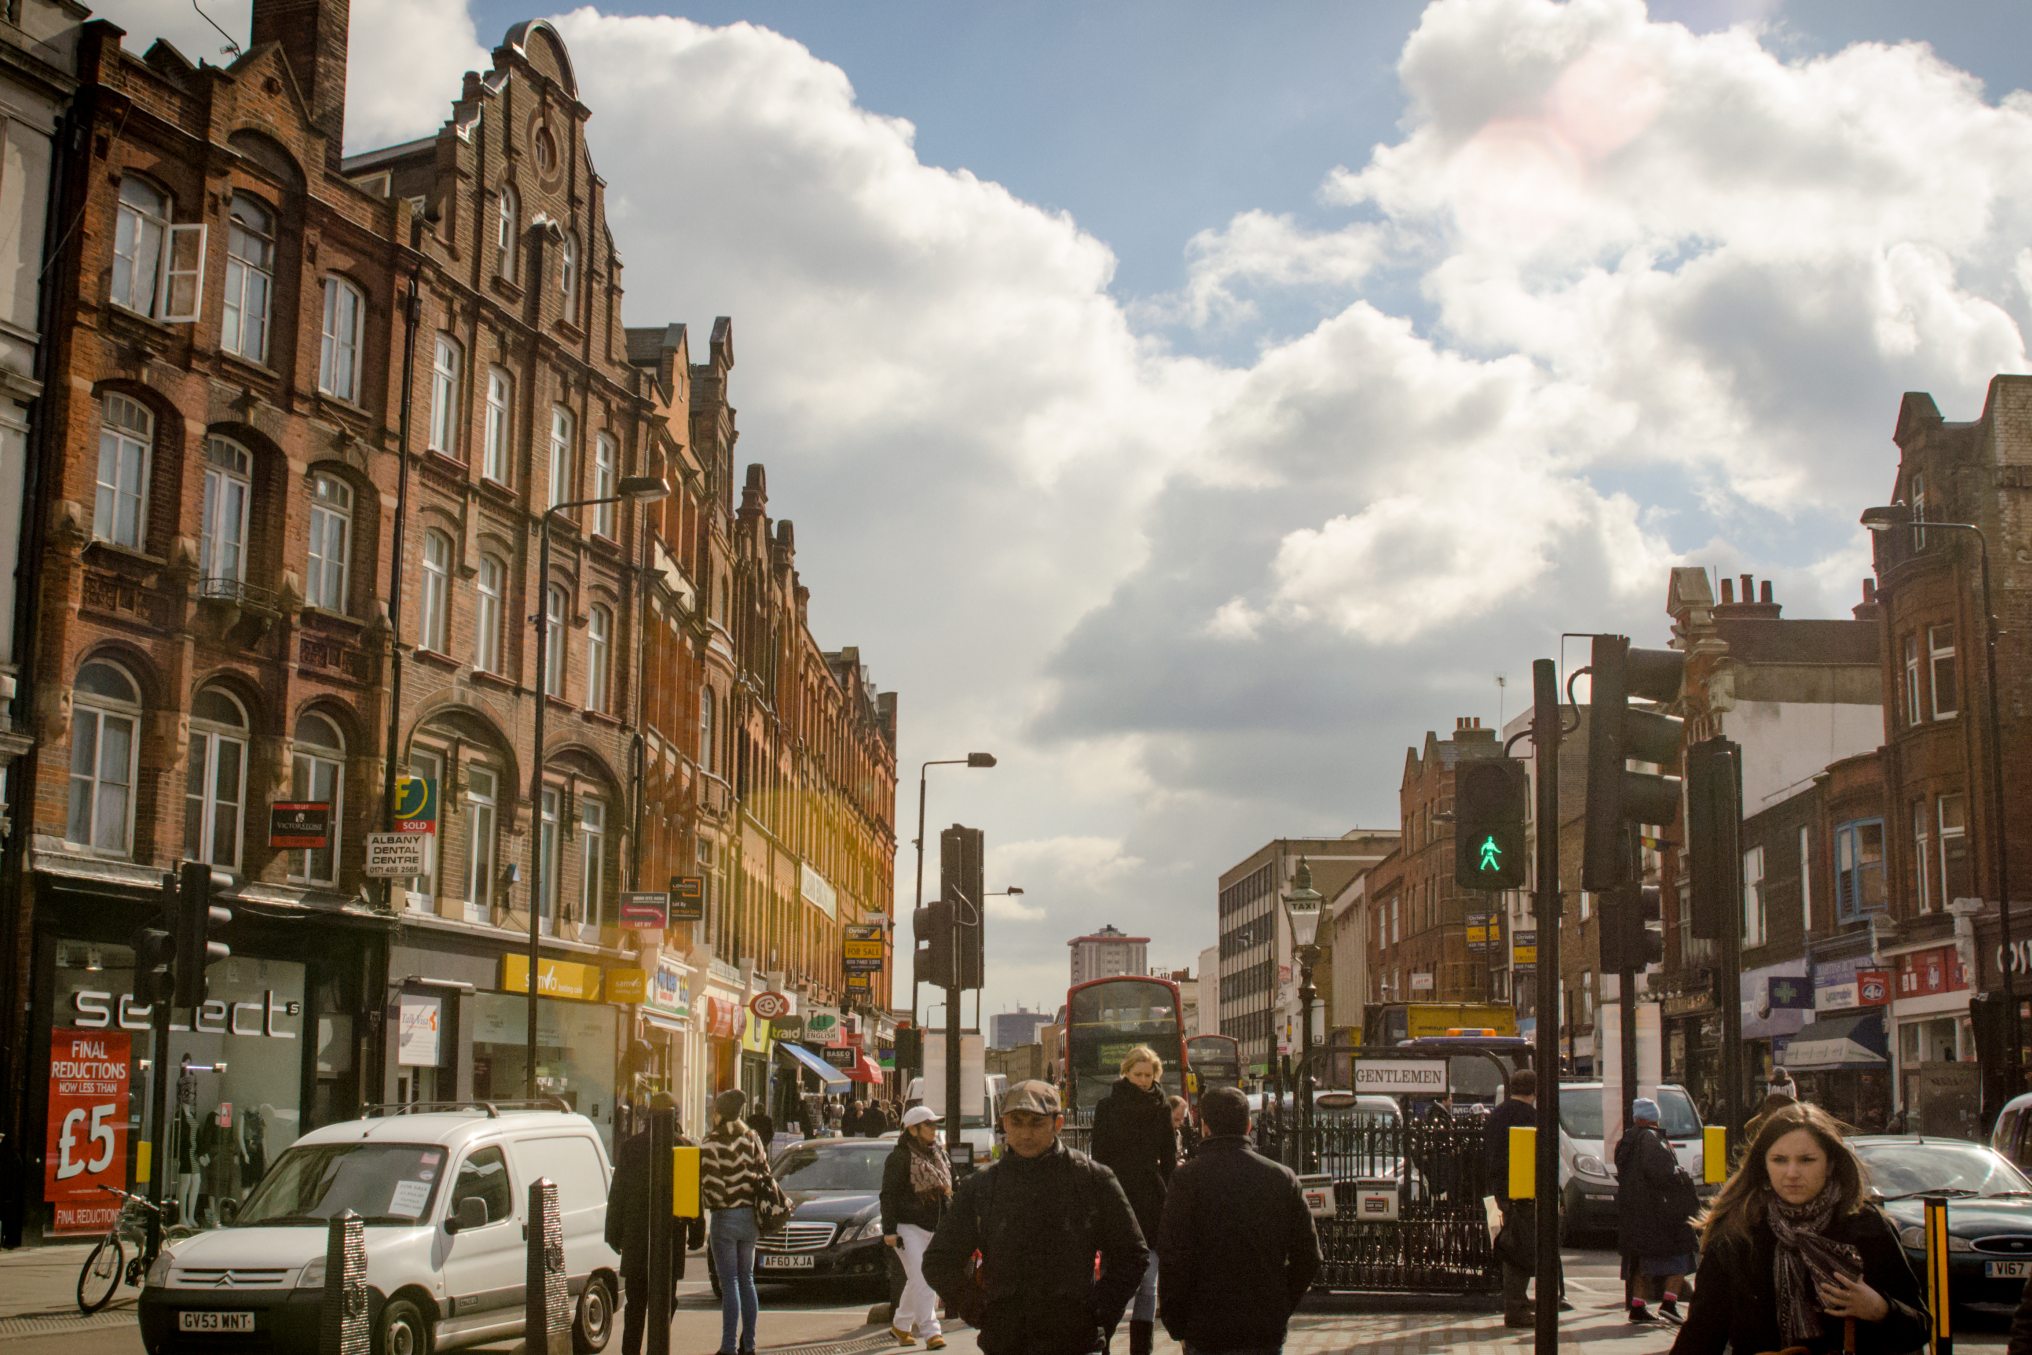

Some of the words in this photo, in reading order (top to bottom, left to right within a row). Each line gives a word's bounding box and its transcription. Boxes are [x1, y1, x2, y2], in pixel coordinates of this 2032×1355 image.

[402, 821, 427, 830] SOLD
[371, 836, 421, 845] ALBANY
[373, 846, 419, 854] DENTAL
[372, 856, 419, 864] CENTRE
[74, 989, 296, 1039] seect
[771, 1026, 801, 1039] traid
[71, 1040, 108, 1059] FINAL
[51, 1061, 126, 1080] REDUCTIONS
[1355, 1069, 1443, 1084] GENTLEMEN
[59, 1082, 78, 1094] NOW
[79, 1082, 95, 1094] LESS
[97, 1081, 118, 1094] THAN
[57, 1103, 116, 1180] £5
[56, 1209, 76, 1225] FINAL
[765, 1256, 790, 1266] AF60
[793, 1256, 813, 1266] XJA
[184, 1314, 218, 1328] GV53
[221, 1314, 248, 1329] WNT
